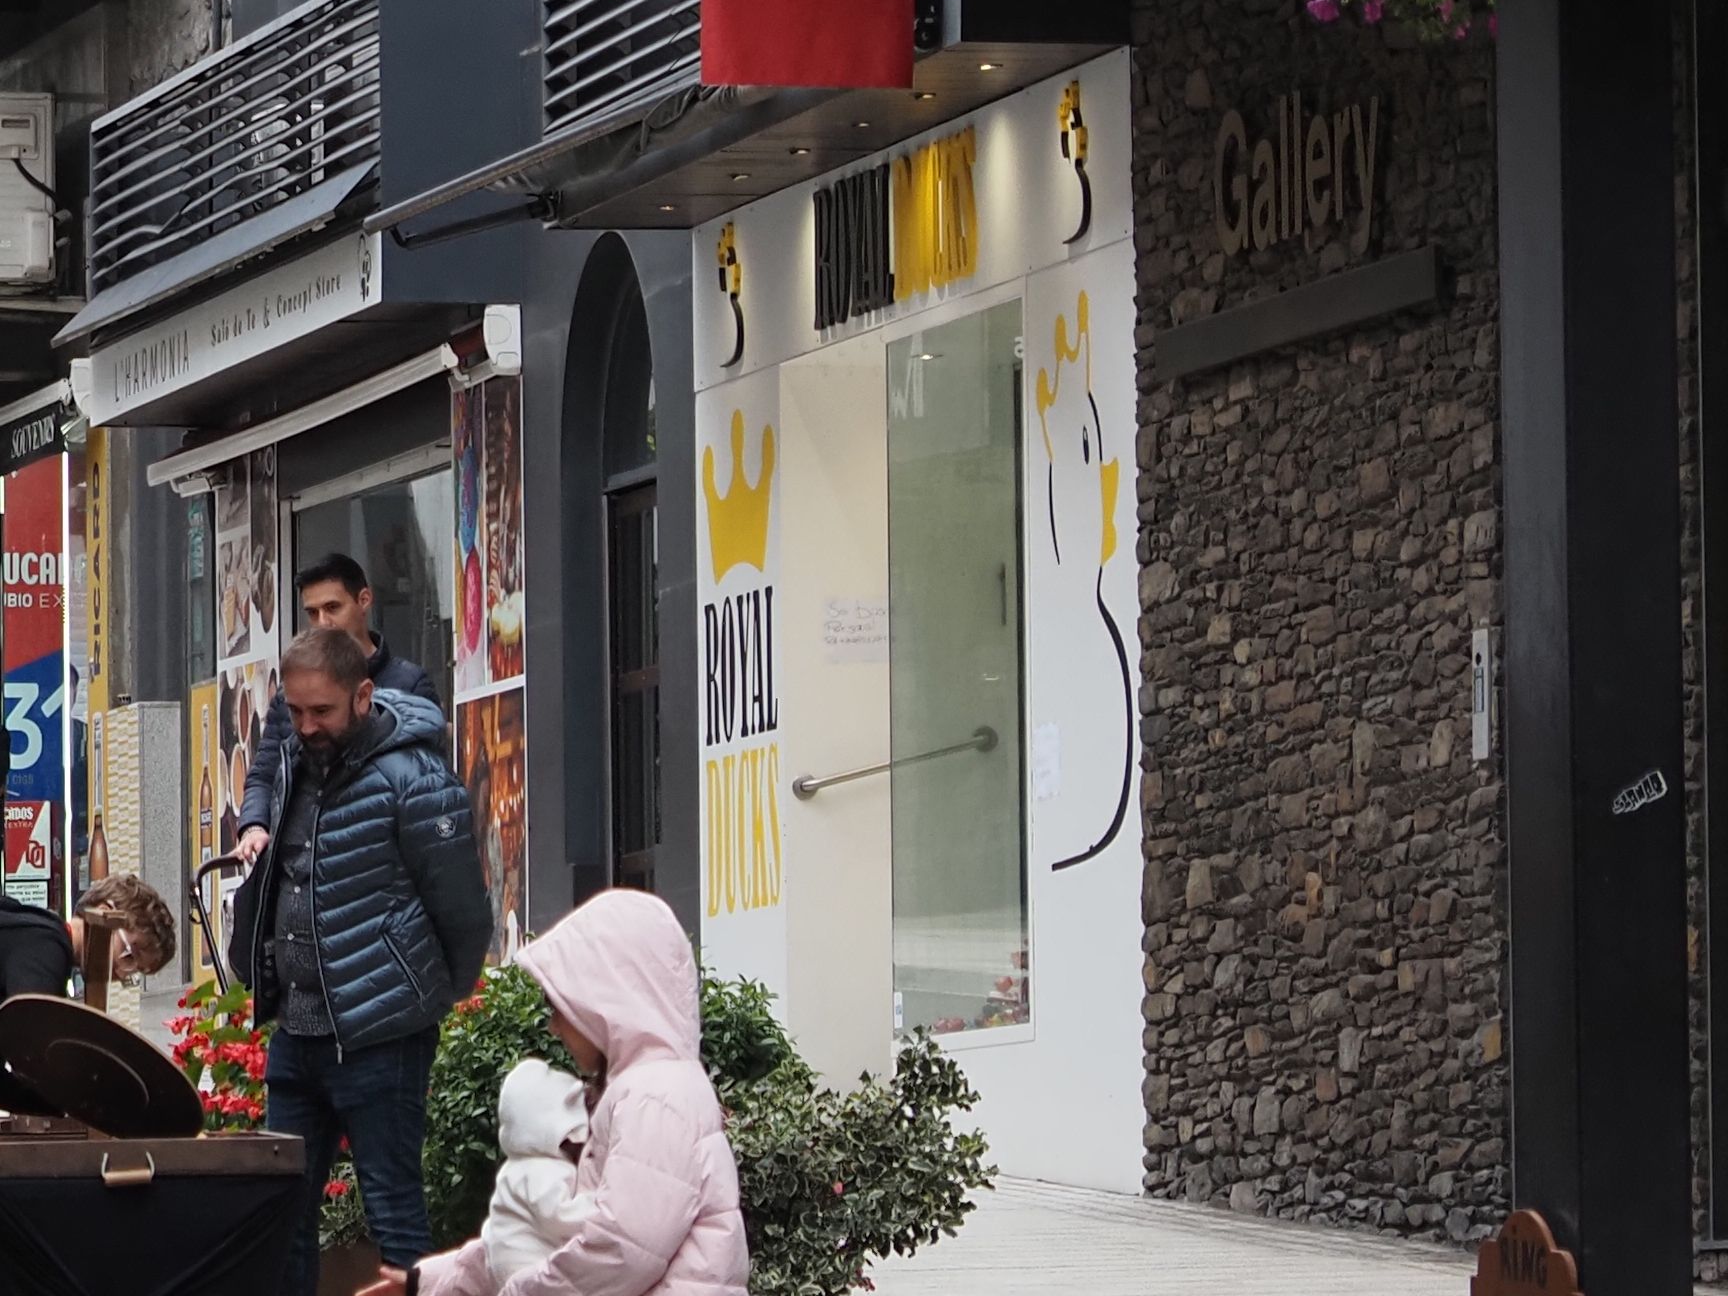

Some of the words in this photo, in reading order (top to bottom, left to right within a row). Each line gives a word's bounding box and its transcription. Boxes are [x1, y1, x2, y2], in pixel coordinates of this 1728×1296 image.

[813, 163, 895, 331] ROYAL
[1215, 90, 1379, 256] Gallery
[113, 329, 190, 403] L'HARMONIA
[263, 297, 271, 329] &
[276, 283, 312, 318] Concept
[315, 273, 341, 301] Store
[704, 585, 779, 747] ROYAL
[705, 741, 781, 918] DUCKS
